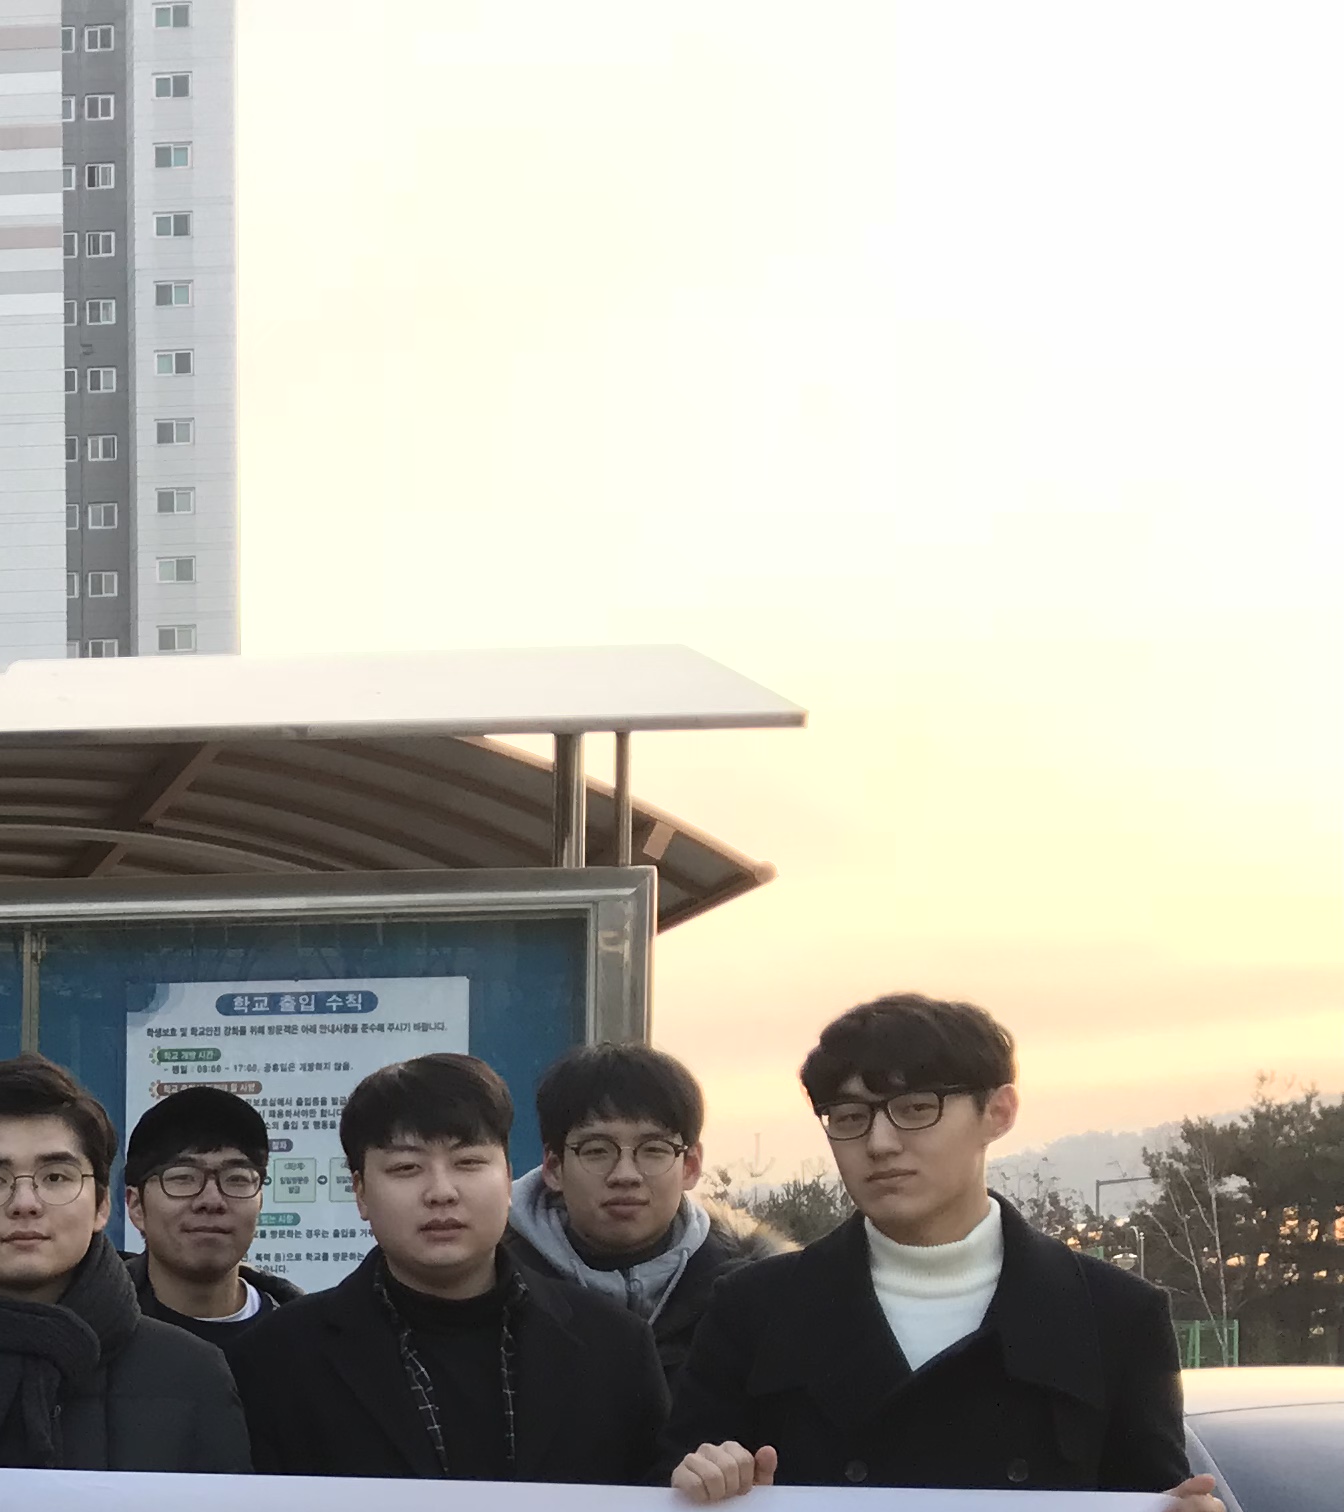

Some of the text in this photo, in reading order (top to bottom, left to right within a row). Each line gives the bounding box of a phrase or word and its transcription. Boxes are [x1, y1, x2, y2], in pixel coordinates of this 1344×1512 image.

[232, 993, 363, 1013] 학교 출입 수칙
